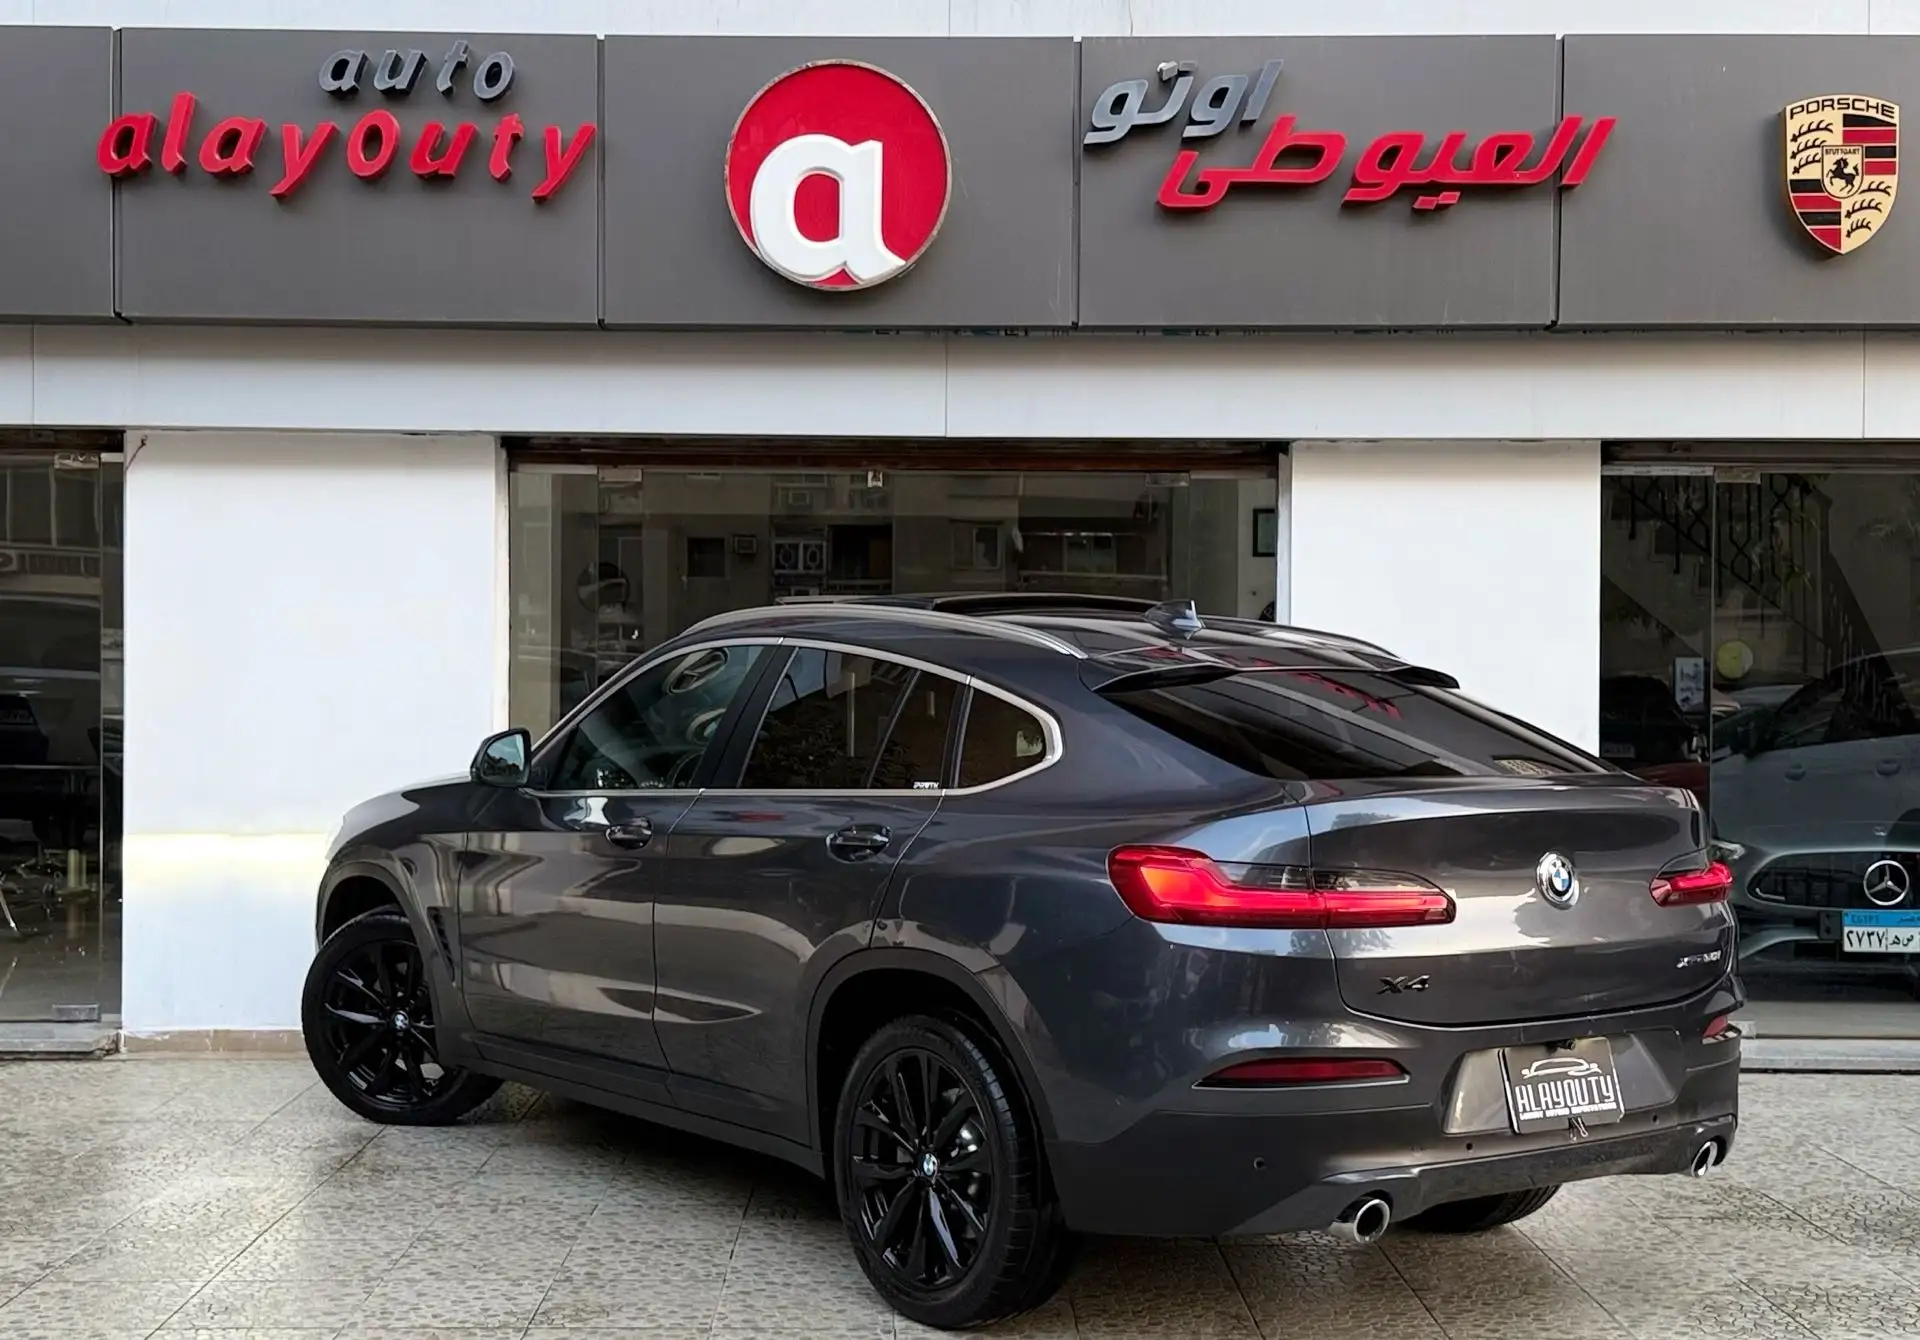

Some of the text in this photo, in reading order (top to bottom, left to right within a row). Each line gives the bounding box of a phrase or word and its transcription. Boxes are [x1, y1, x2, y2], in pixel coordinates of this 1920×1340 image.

[318, 40, 516, 101] auto
[1789, 97, 1896, 120] PORSCHE
[96, 91, 598, 203] alayouty
[1376, 974, 1430, 995] X4
[1515, 1075, 1615, 1113] ALAYOUTY
